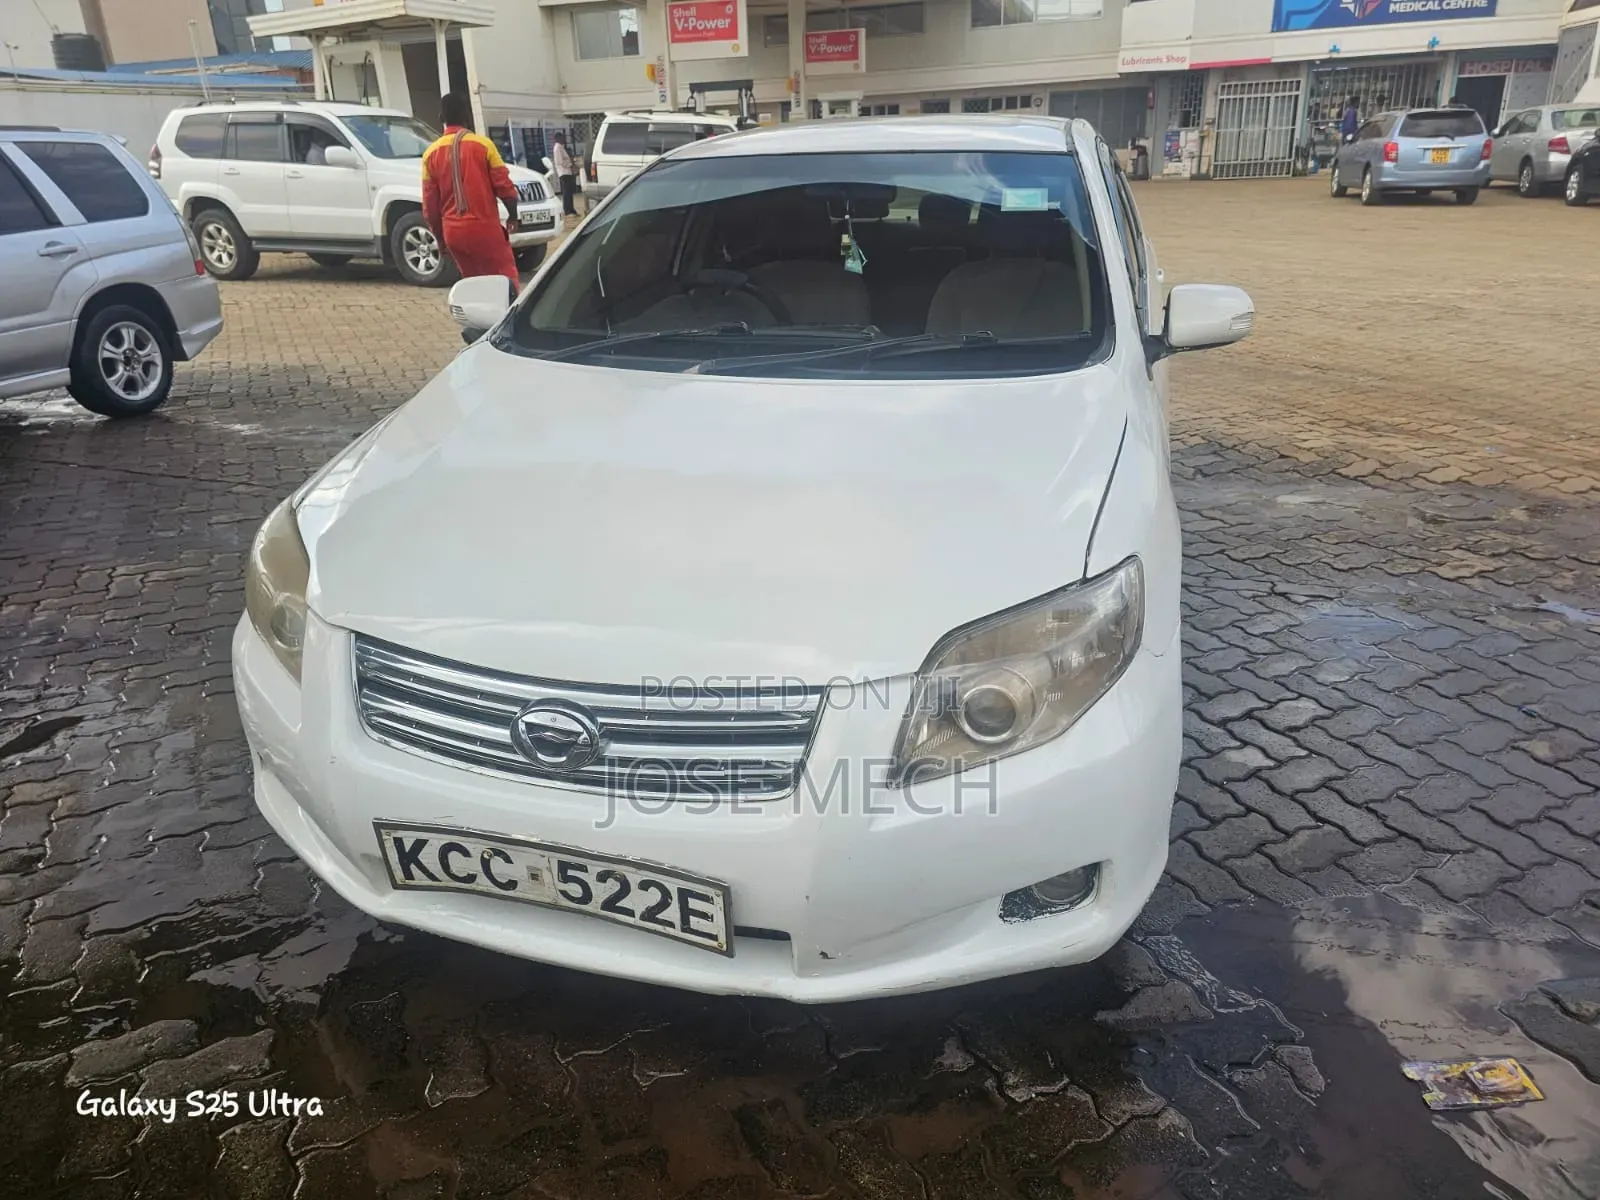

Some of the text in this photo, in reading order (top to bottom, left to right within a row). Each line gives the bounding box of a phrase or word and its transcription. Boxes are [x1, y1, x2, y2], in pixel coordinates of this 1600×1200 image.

[673, 7, 697, 17] Shell
[1388, 0, 1488, 13] MEDICAL CENTRE
[674, 18, 731, 31] V-Power
[808, 44, 854, 54] V-Power
[1121, 54, 1187, 66] Lubricants Shop
[392, 835, 719, 942] KCC 522E
